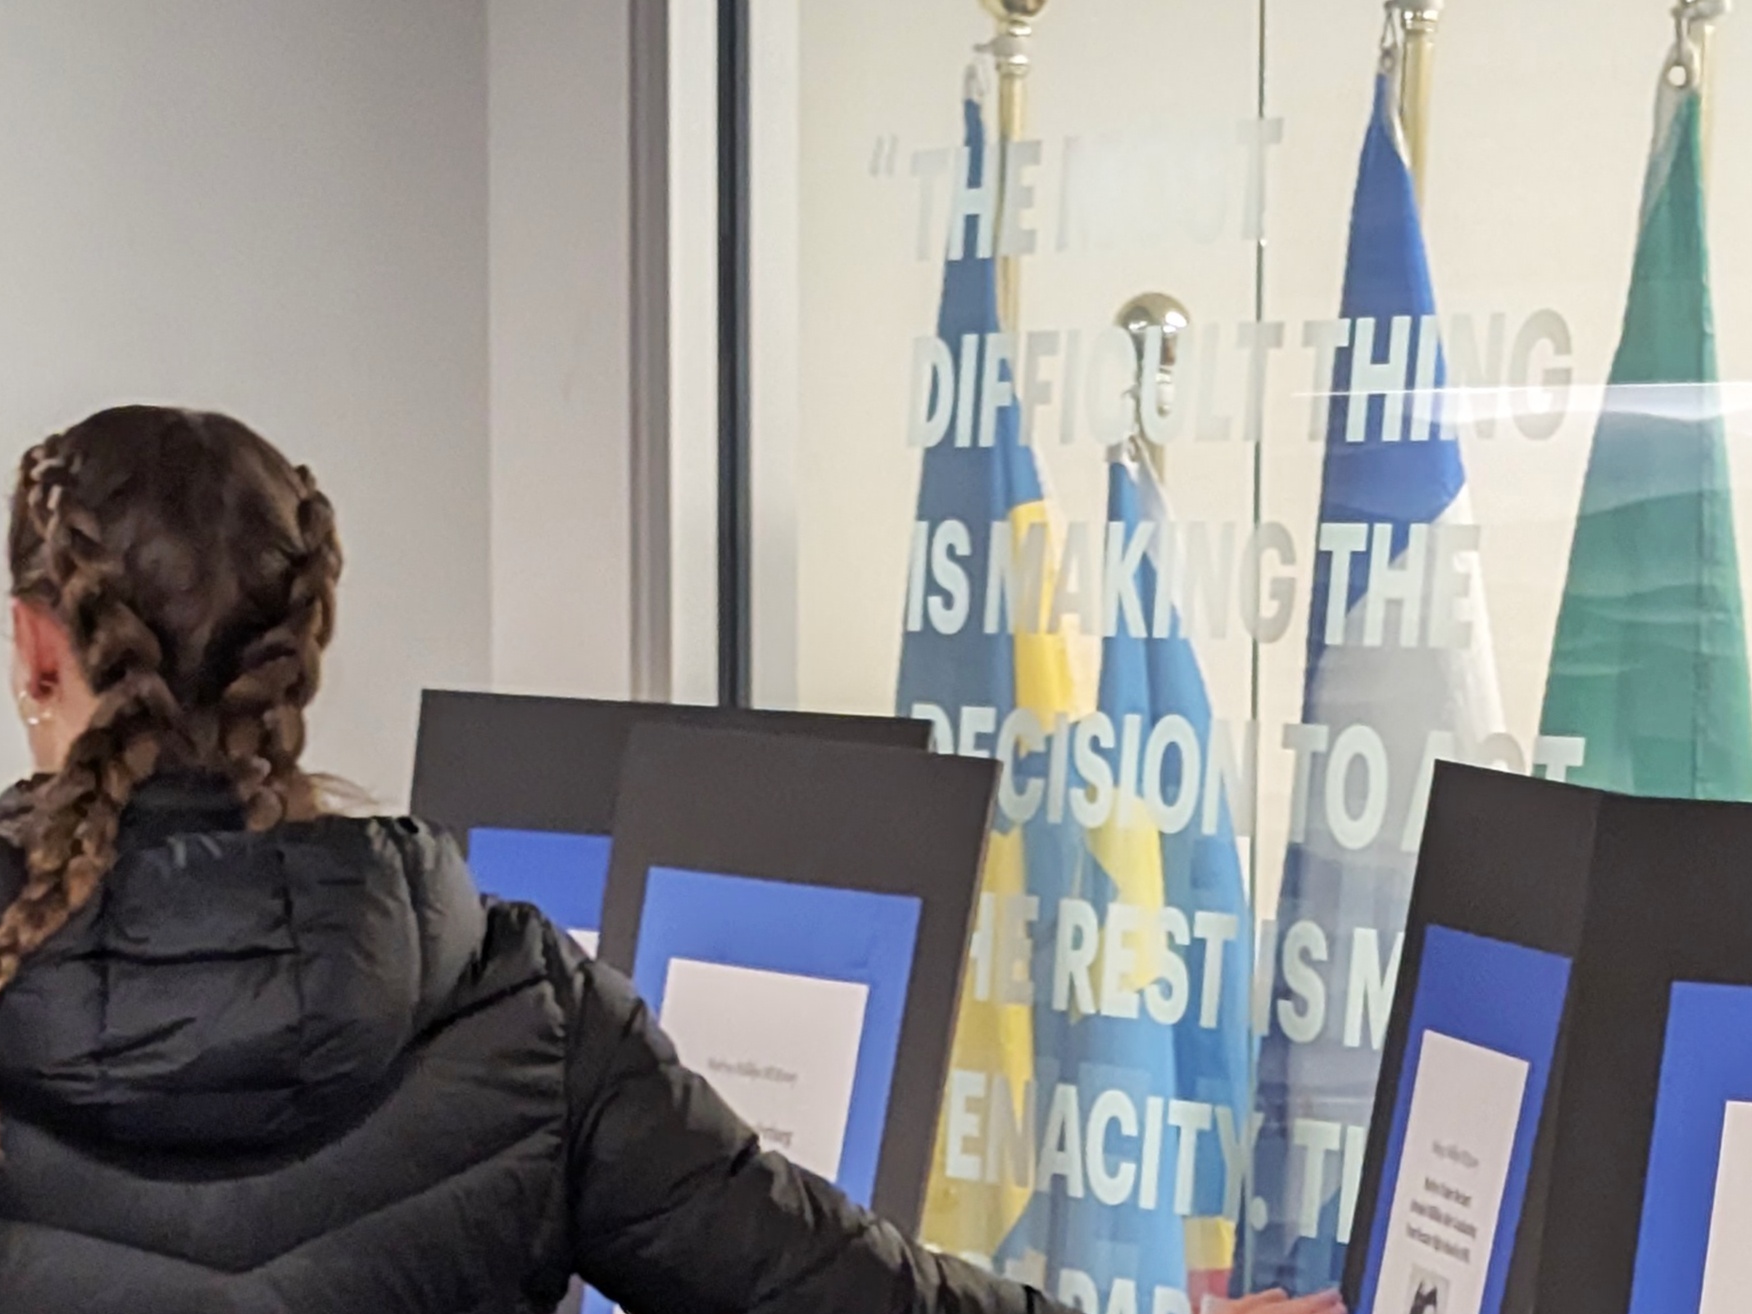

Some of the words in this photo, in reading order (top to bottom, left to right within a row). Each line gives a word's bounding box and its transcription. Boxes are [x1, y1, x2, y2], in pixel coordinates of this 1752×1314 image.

[906, 322, 1284, 449] DIFFICULT
[1303, 307, 1574, 445] THING
[906, 519, 972, 636] IS
[984, 520, 1297, 644] MAKING
[1318, 521, 1482, 648] THE
[1281, 720, 1388, 851] TO
[1052, 898, 1238, 1029] REST
[1253, 917, 1328, 1044] IS
